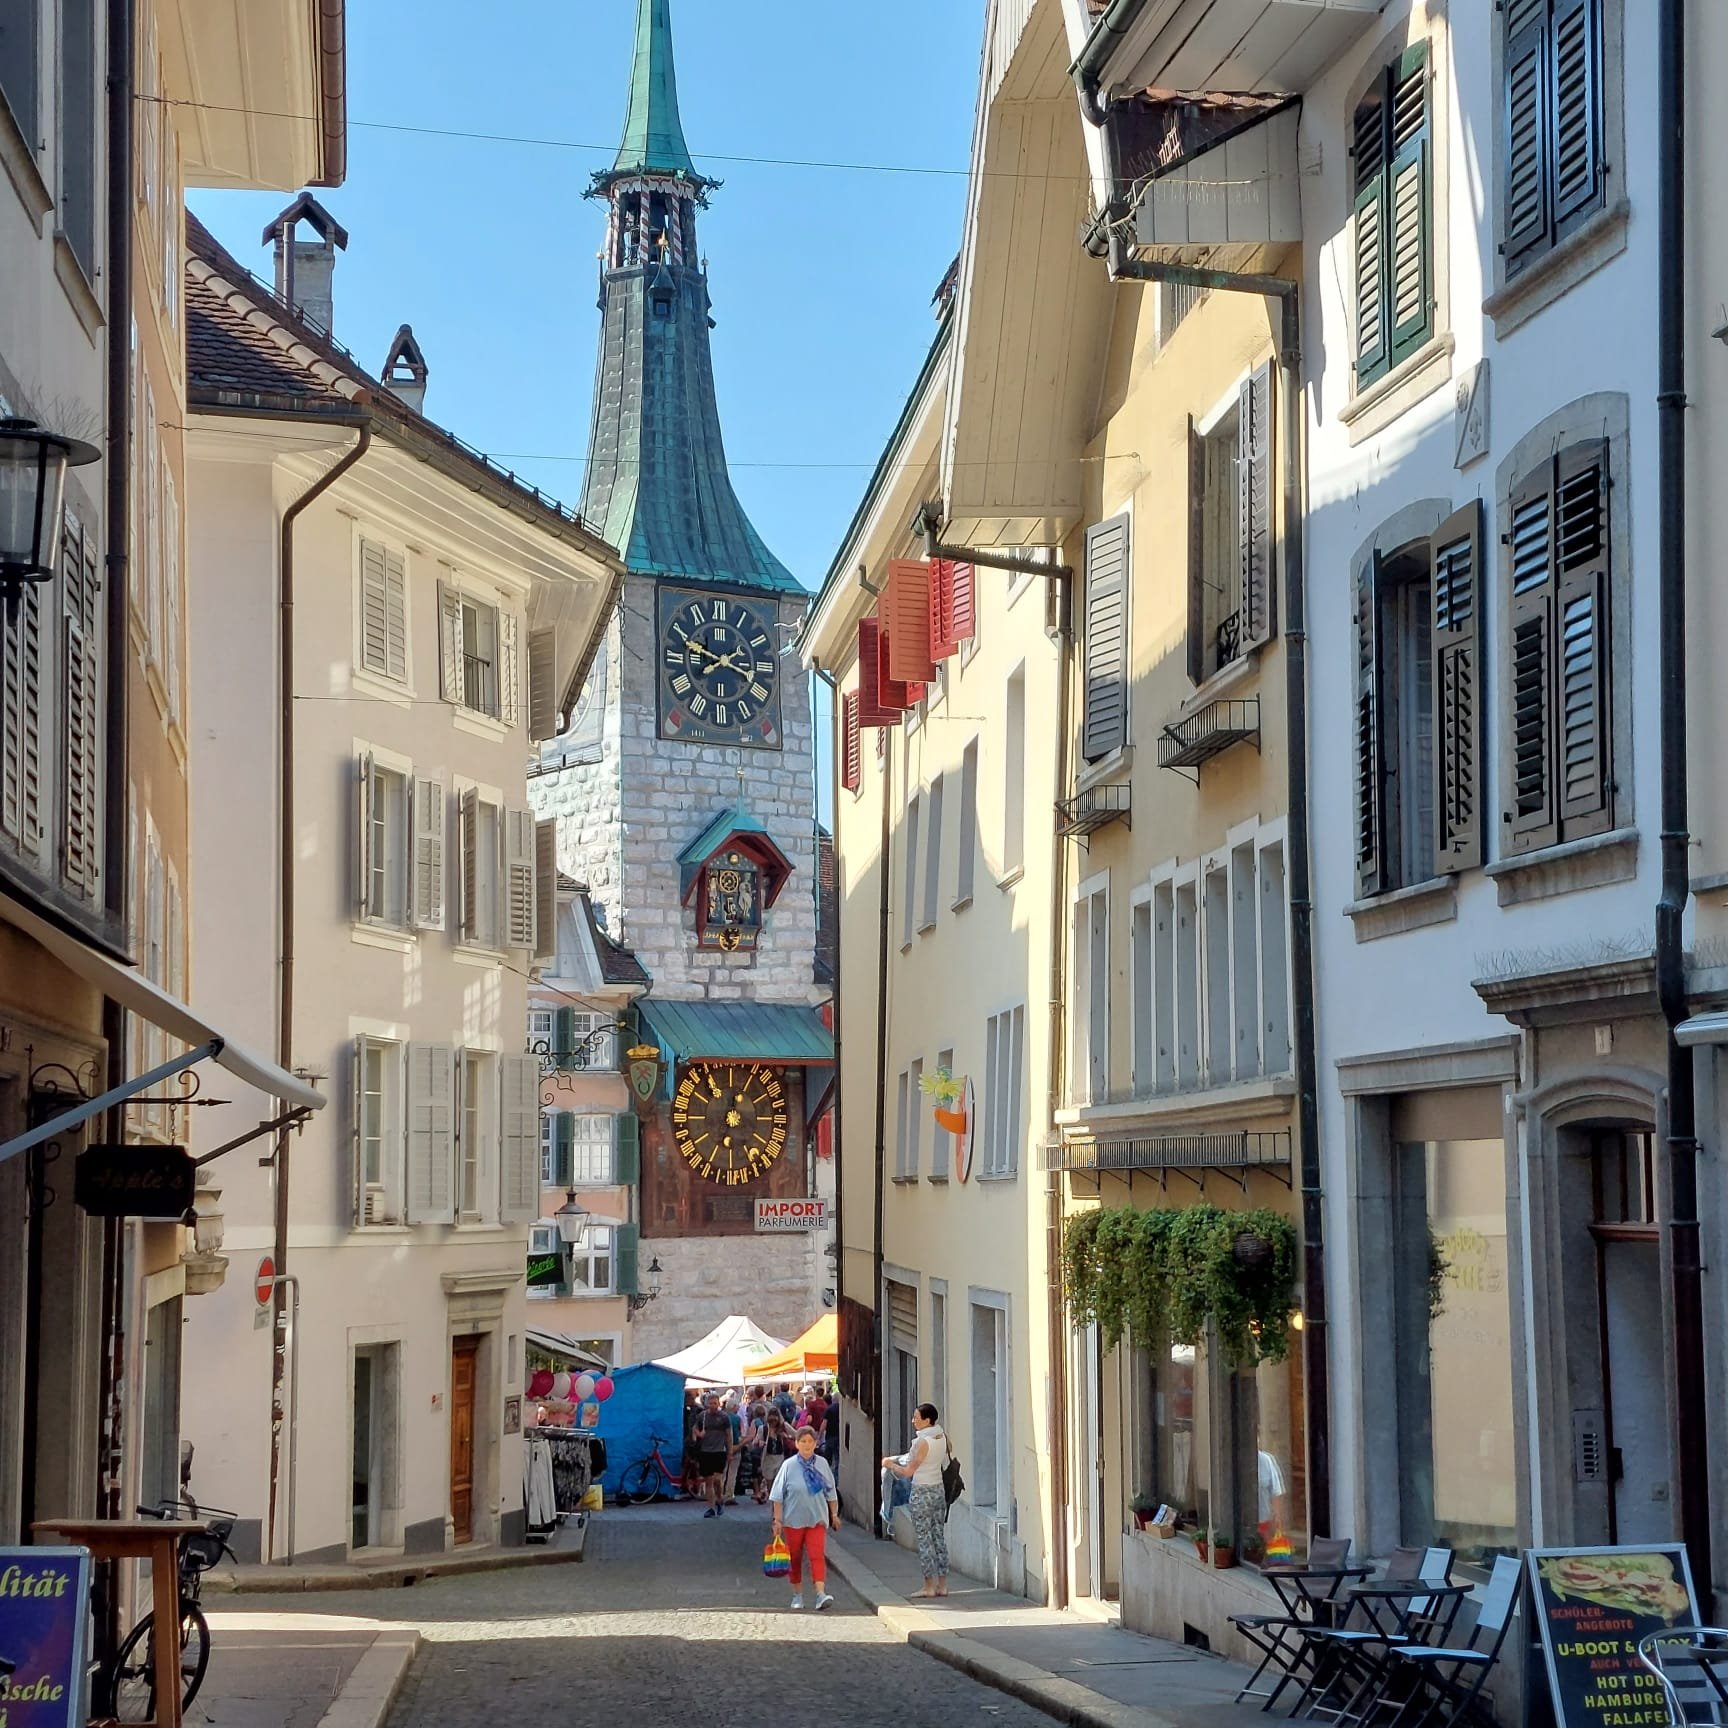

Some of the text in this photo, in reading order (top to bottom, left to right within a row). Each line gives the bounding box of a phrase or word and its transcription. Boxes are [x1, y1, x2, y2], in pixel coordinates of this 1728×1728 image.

[759, 1202, 825, 1217] IMPORT
[758, 1217, 825, 1228] PARFUMERIE
[1575, 1619, 1635, 1632] ANGEBOTE
[1557, 1641, 1619, 1656] U-BOOT
[1625, 1640, 1636, 1654] &
[1590, 1656, 1621, 1669] AUCH
[1596, 1676, 1627, 1690] HOT
